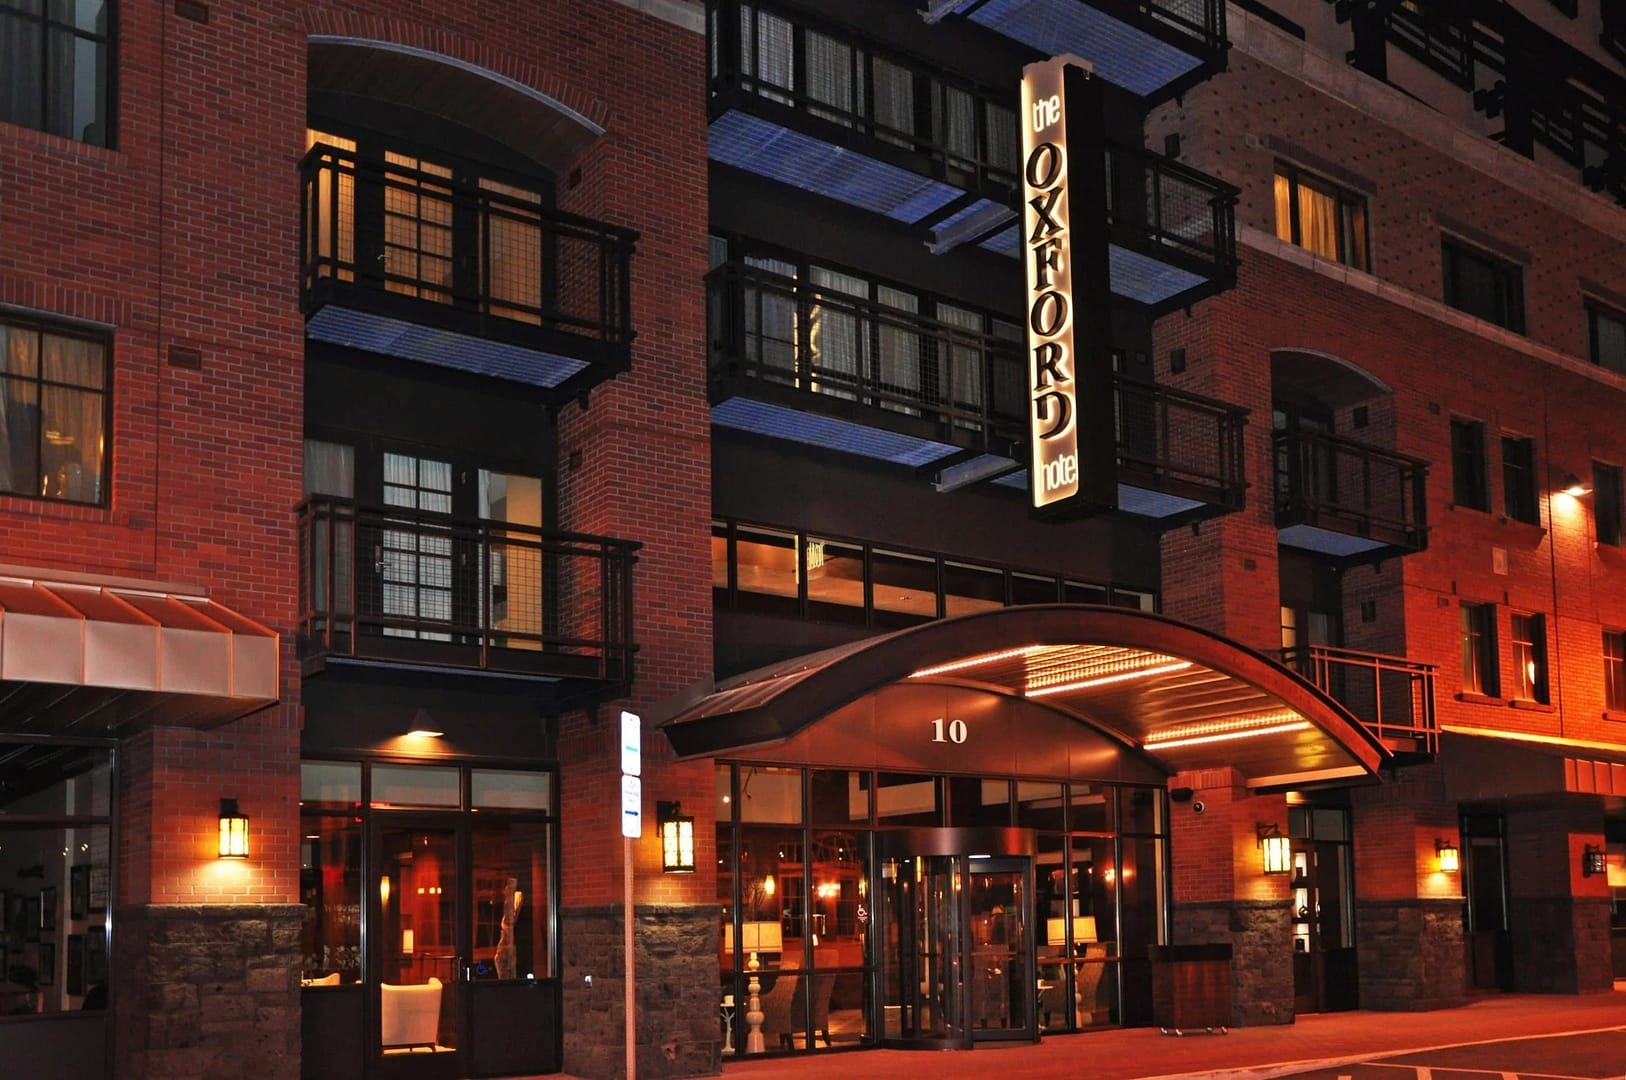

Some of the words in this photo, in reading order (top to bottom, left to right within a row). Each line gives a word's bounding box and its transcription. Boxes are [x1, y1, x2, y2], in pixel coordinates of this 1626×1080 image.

[1032, 95, 1061, 133] the
[1026, 142, 1071, 440] OXFORD
[1039, 449, 1078, 493] hotel
[931, 718, 968, 744] 10
